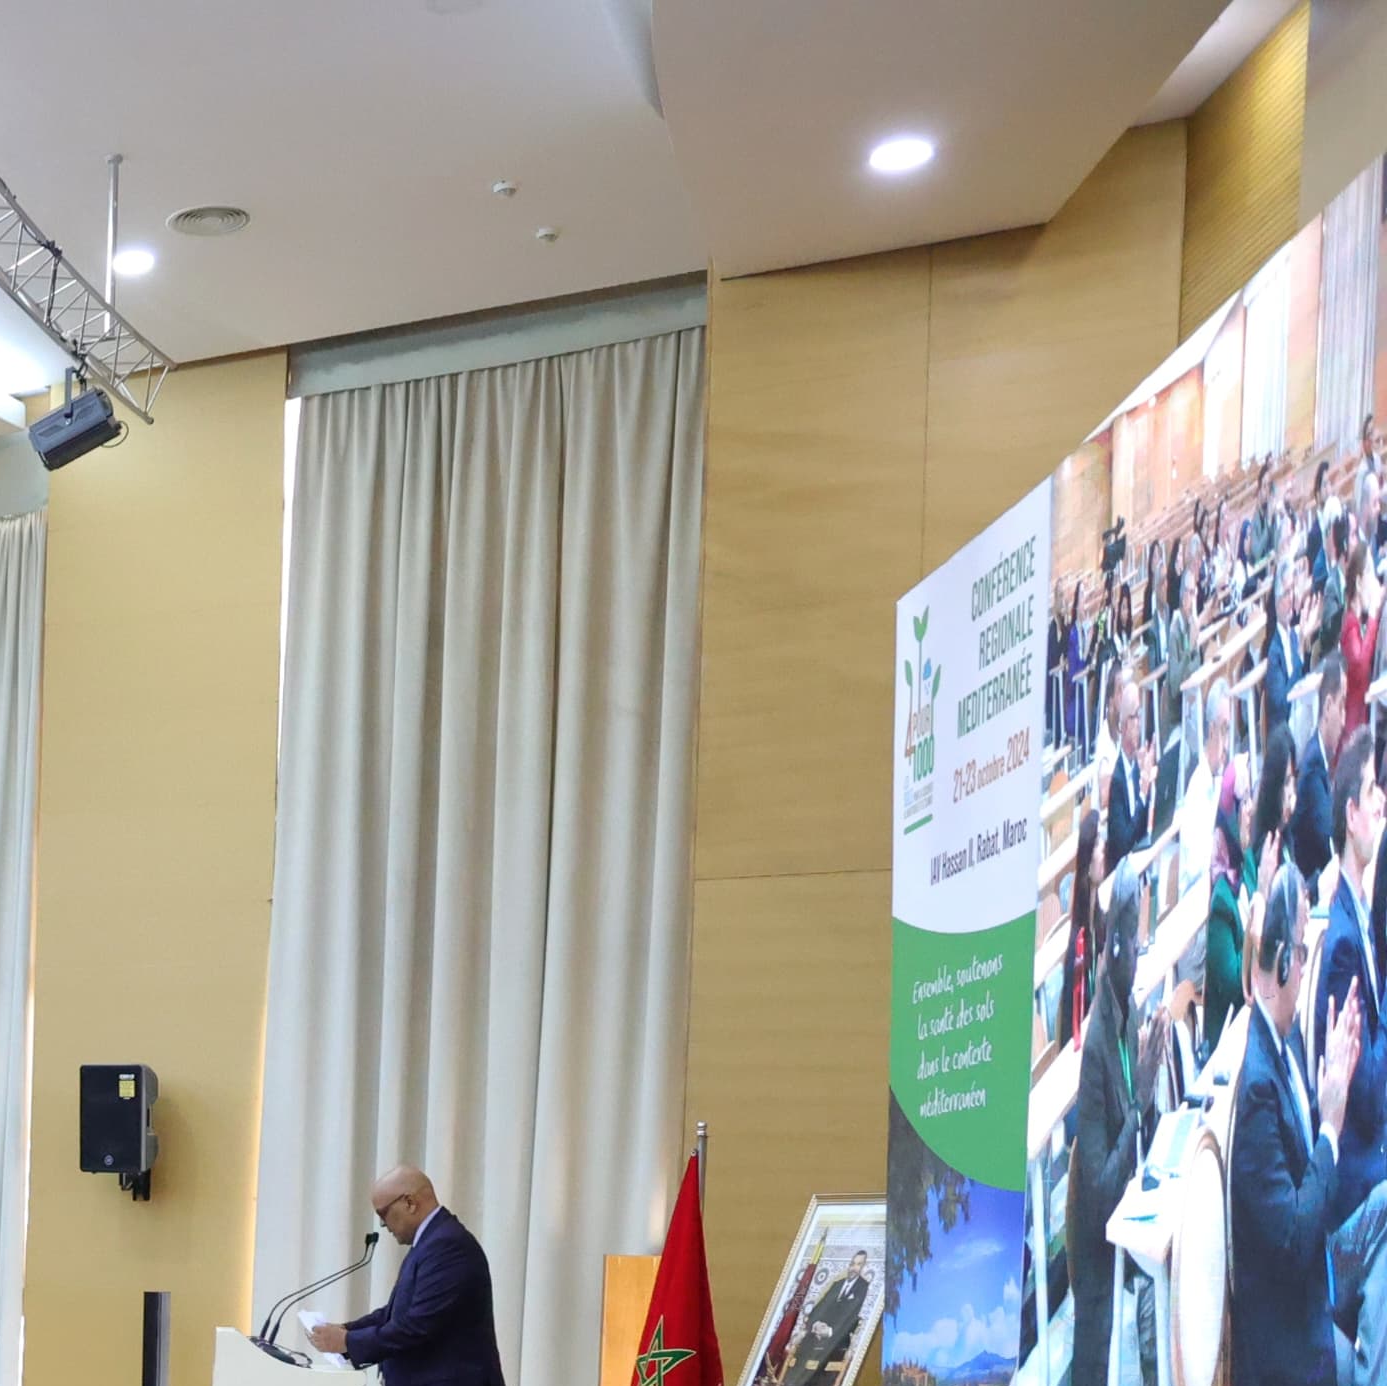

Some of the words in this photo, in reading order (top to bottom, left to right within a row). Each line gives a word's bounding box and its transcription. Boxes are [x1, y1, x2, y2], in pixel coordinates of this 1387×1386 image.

[971, 534, 1036, 622] CONFÉRENCE
[979, 593, 1034, 670] REGIONALE
[957, 646, 1032, 739] MEDITERRANÉE
[953, 758, 976, 804] 21-23
[977, 753, 1005, 789] octobre
[1006, 726, 1030, 774] 2024
[942, 850, 967, 881] Hassan
[976, 826, 1001, 864] Rabat,
[1002, 817, 1027, 850] Maroc
[956, 953, 1003, 987] soutenons
[918, 1013, 928, 1041] la
[929, 1004, 954, 1036] santé
[956, 998, 974, 1029] des
[976, 989, 995, 1023] sols
[917, 1049, 939, 1080] dans
[942, 1045, 950, 1073] le
[952, 1034, 992, 1069] contexte
[920, 1080, 986, 1119] méditerranéen
